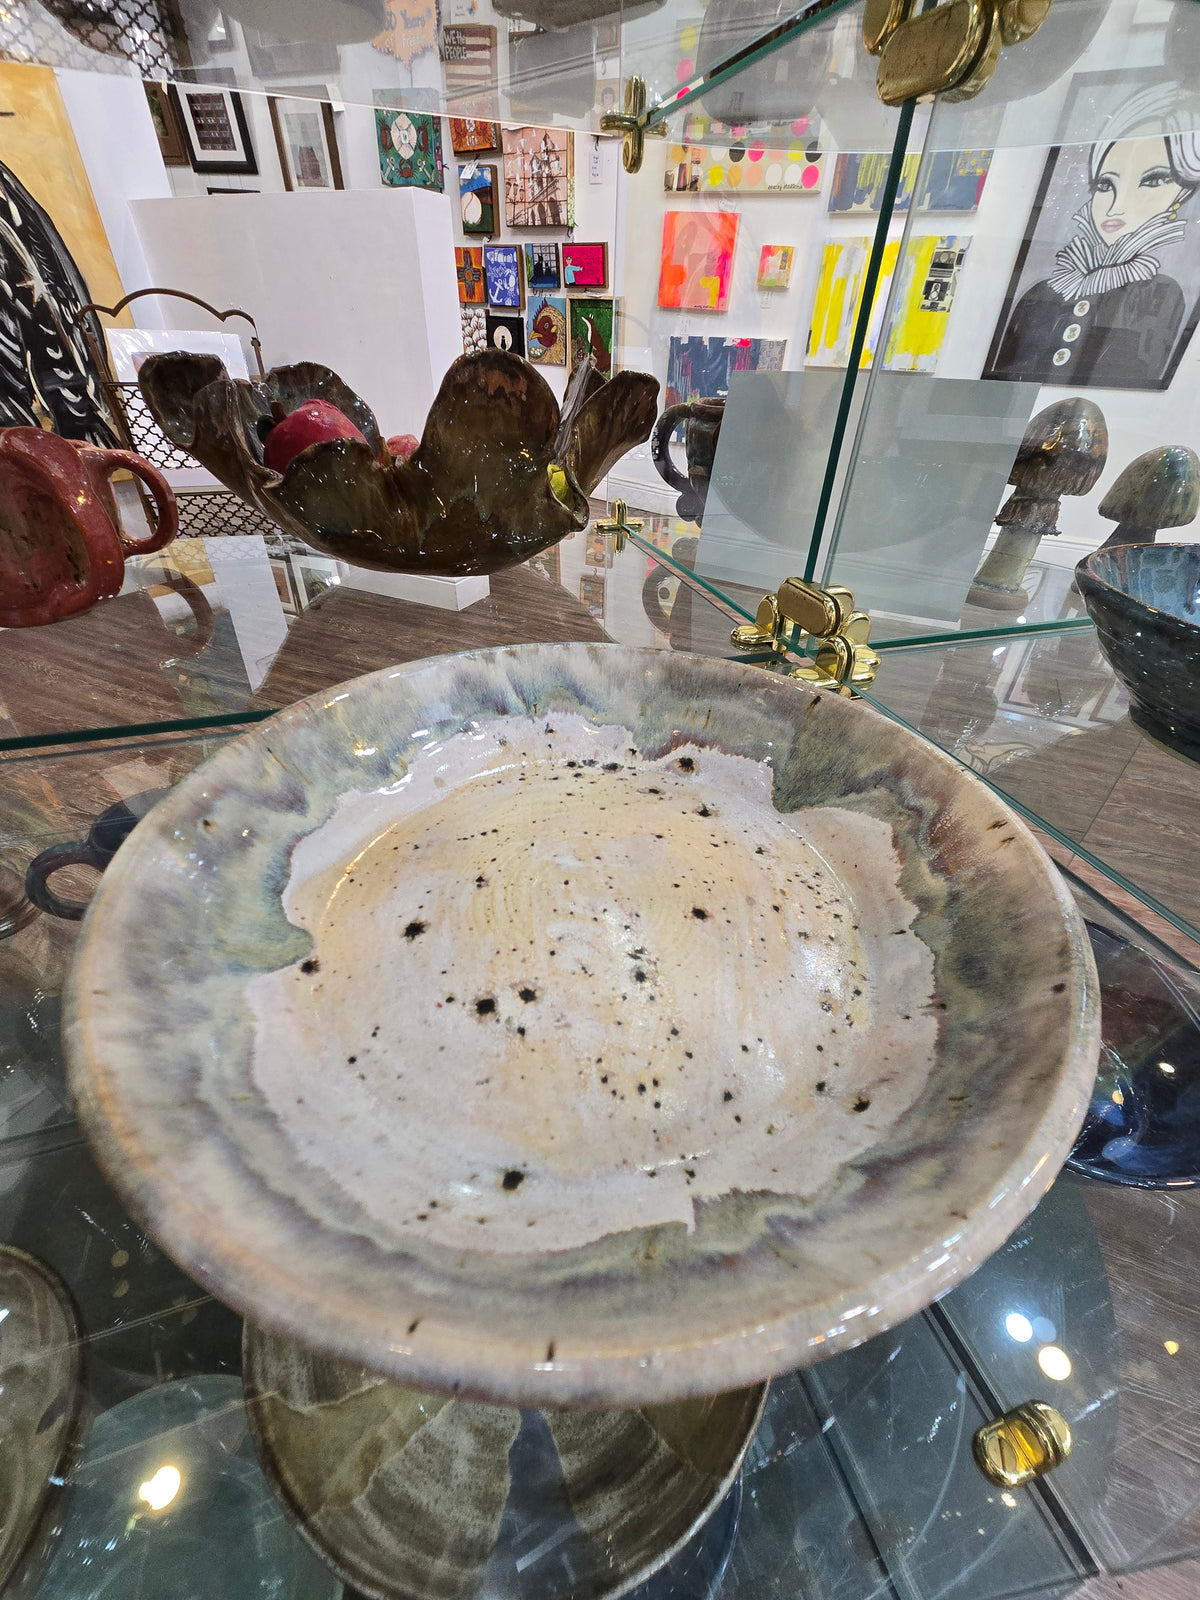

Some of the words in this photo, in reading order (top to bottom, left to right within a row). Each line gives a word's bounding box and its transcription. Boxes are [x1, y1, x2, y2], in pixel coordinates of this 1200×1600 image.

[400, 8, 426, 30] Years
[444, 29, 457, 46] WE
[445, 45, 468, 60] PEOPLE
